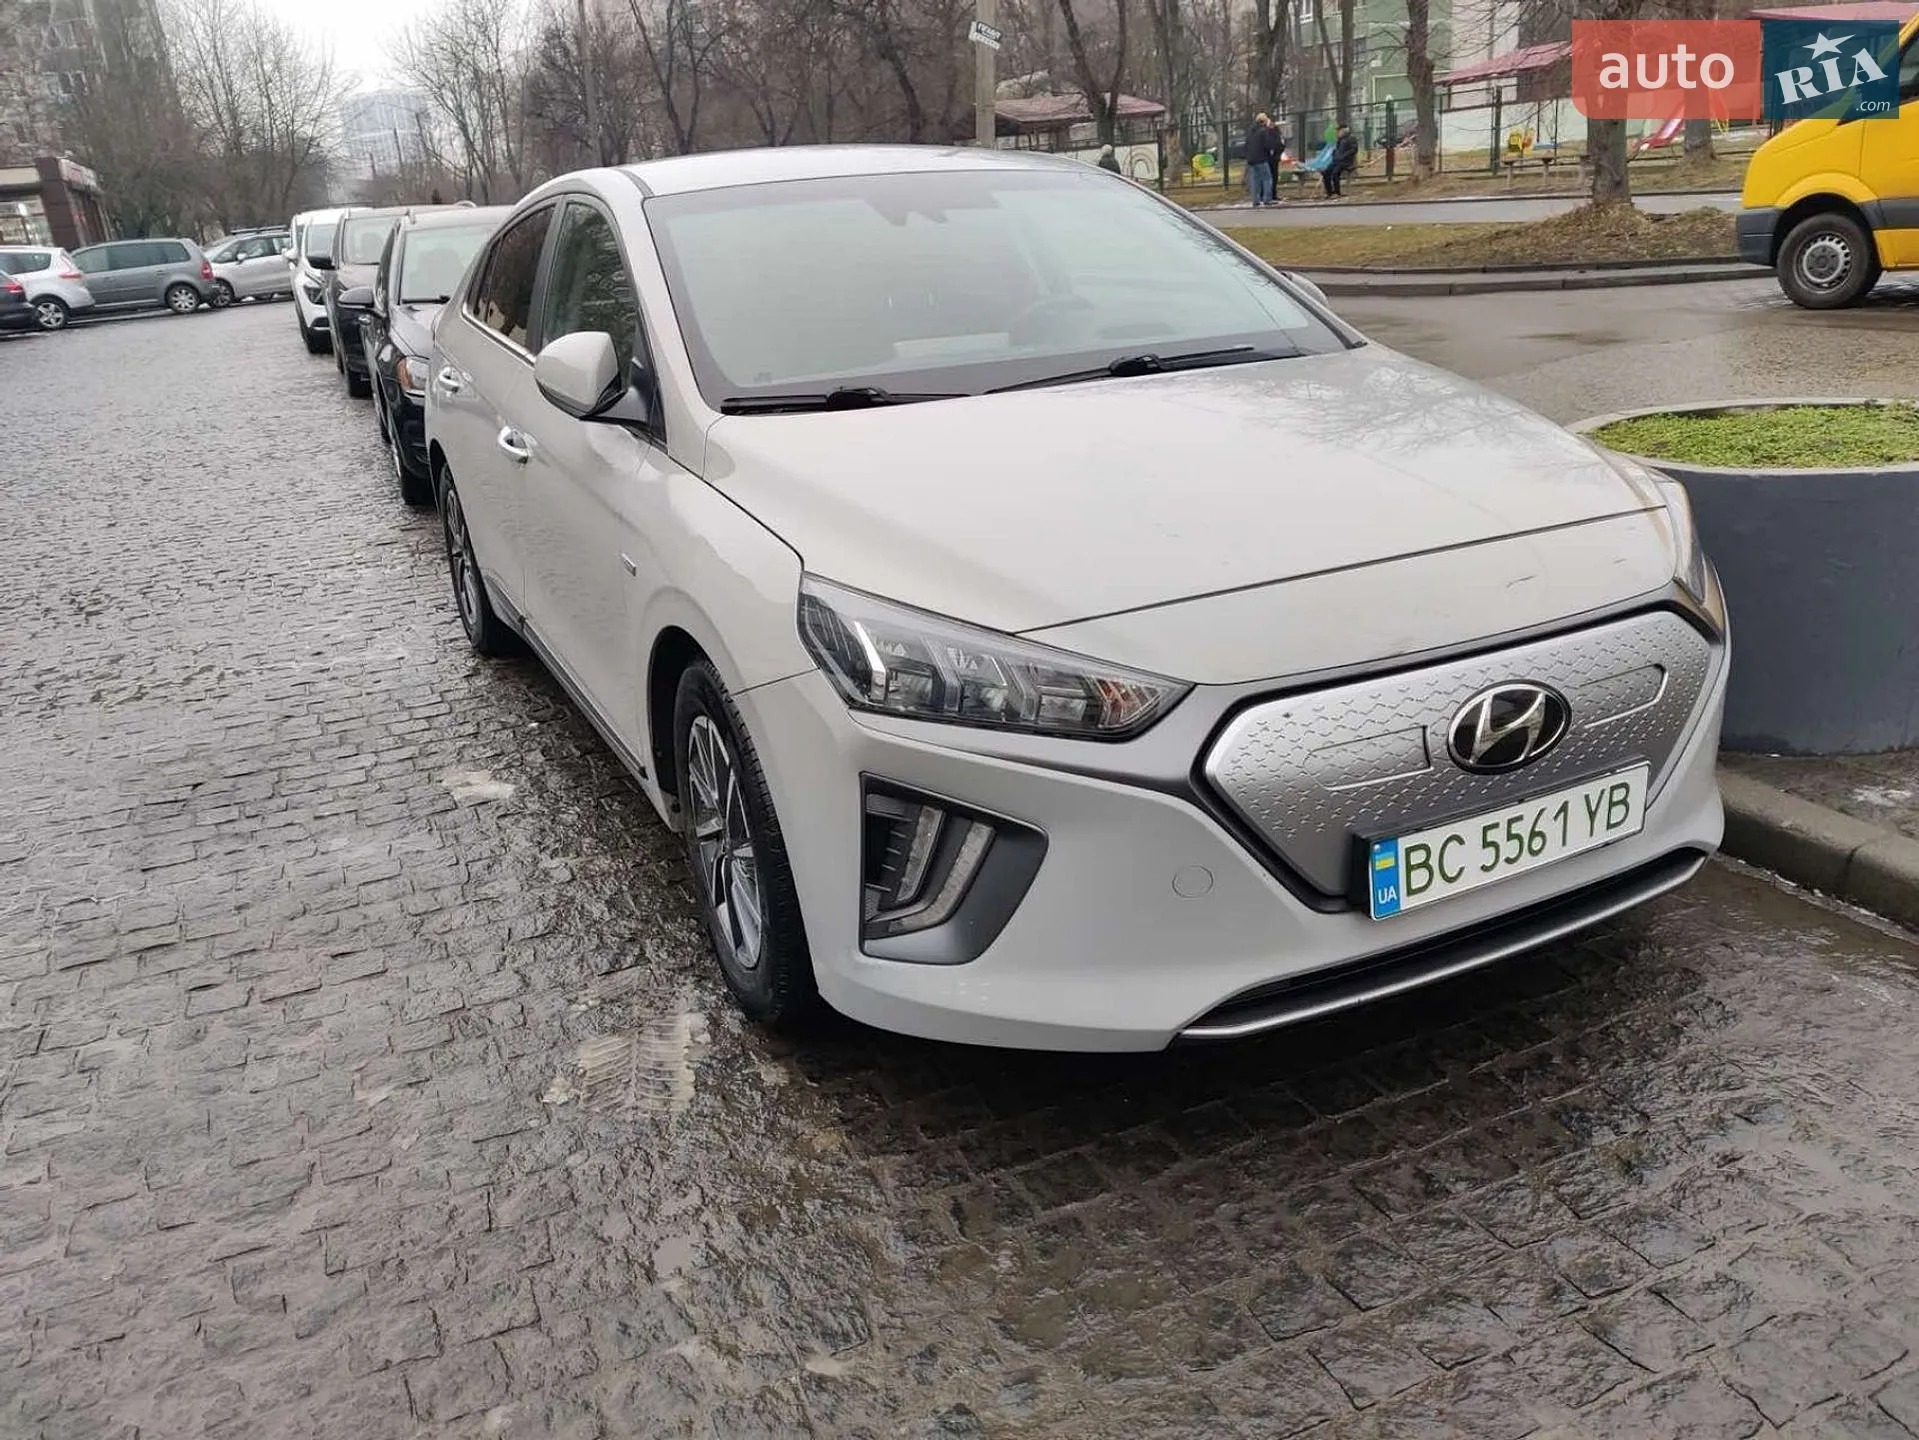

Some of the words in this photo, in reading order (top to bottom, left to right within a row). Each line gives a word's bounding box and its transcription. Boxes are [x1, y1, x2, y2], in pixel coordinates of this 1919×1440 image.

[1404, 834, 1465, 897] BC
[1480, 800, 1570, 873] 5561
[1584, 782, 1630, 837] YB
[1378, 887, 1398, 904] UA
